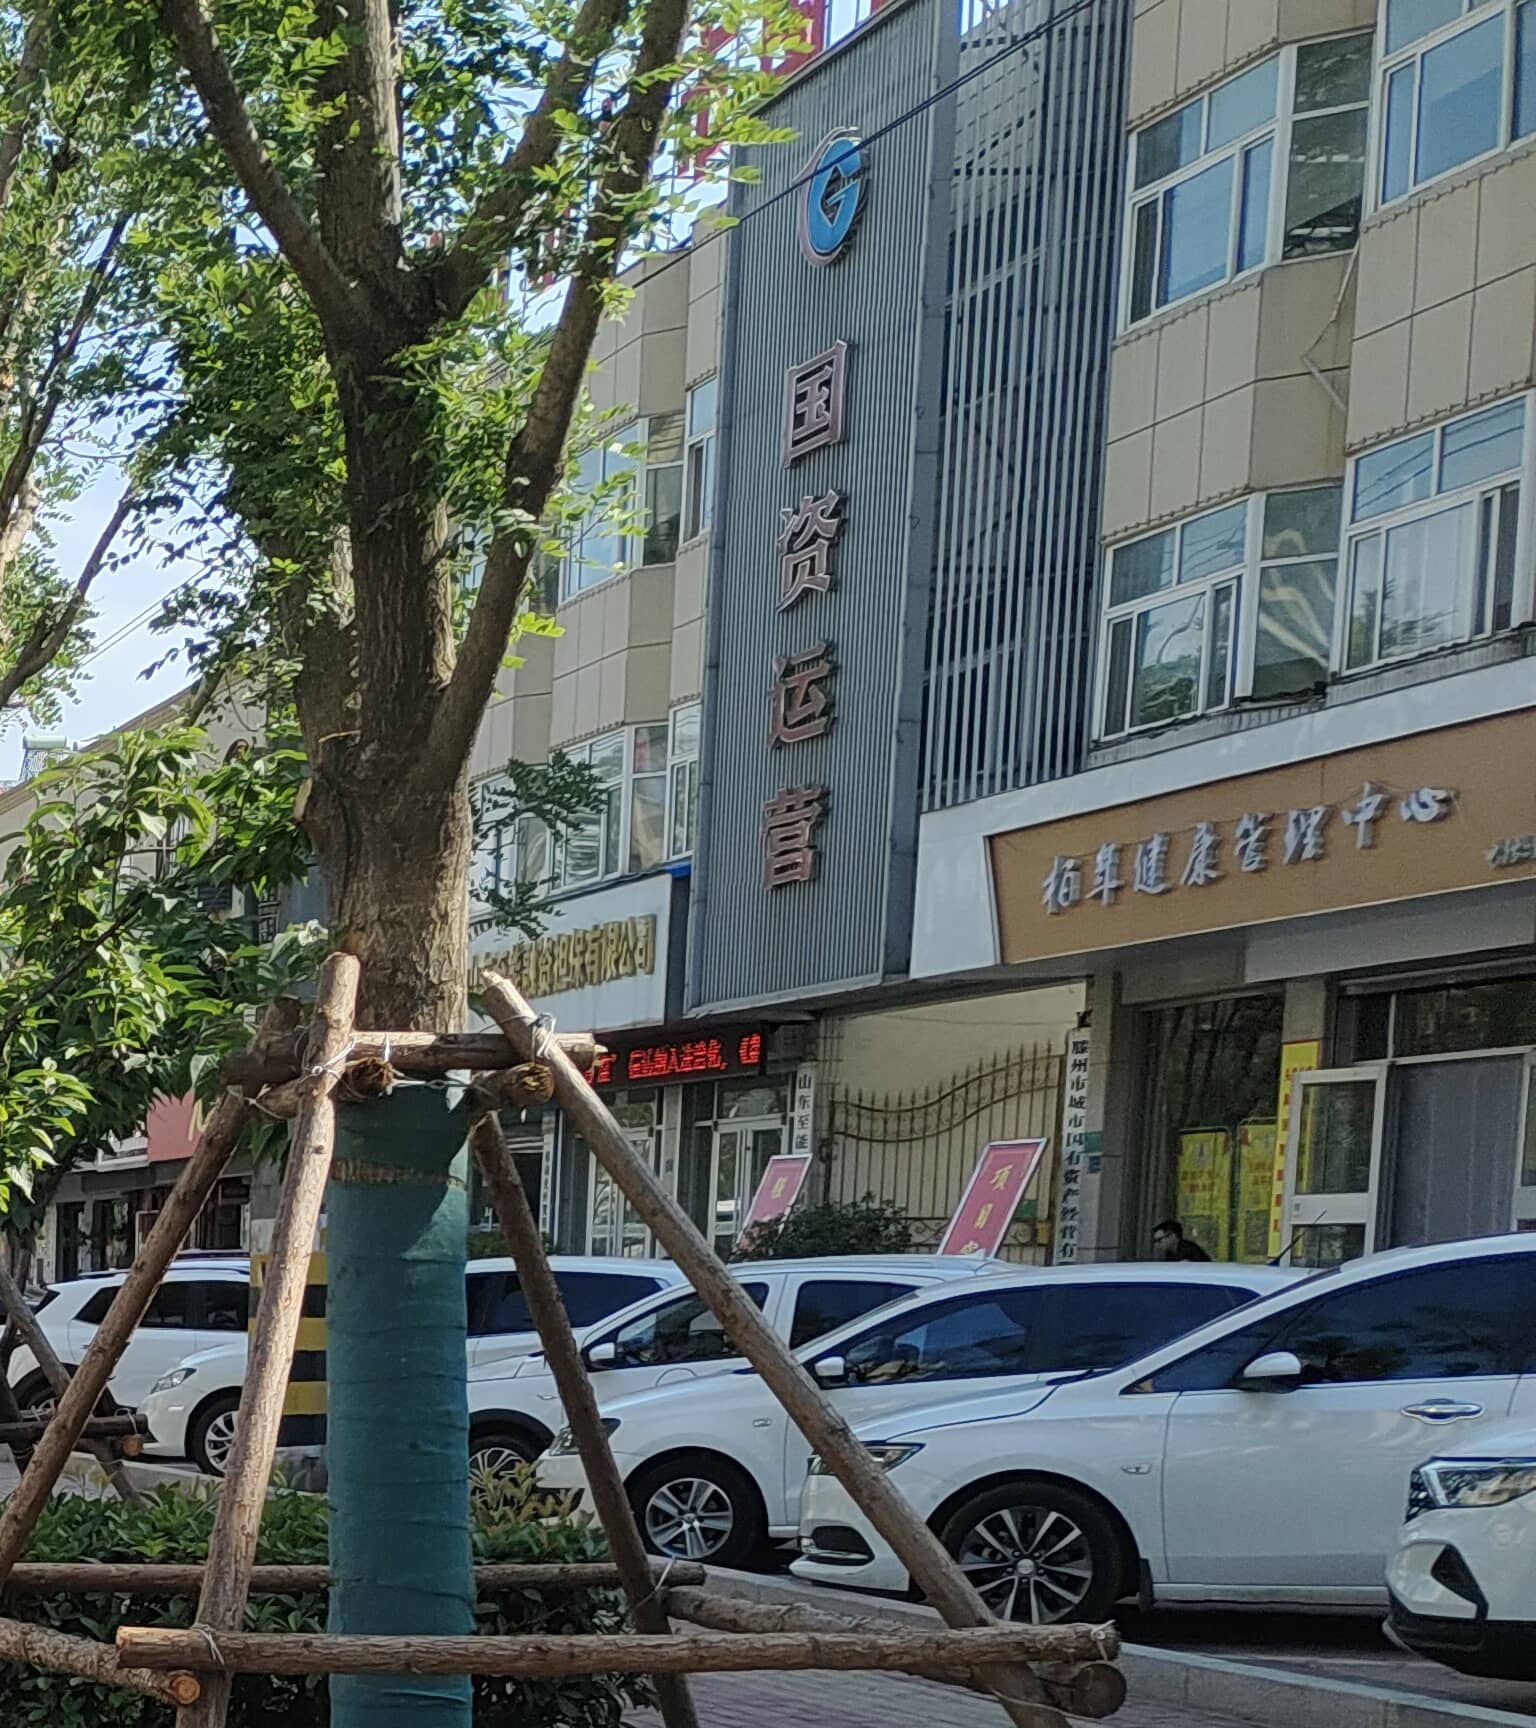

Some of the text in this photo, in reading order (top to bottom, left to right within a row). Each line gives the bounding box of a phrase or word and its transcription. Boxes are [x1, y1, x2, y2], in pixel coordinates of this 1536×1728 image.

[762, 338, 848, 892] 国资运营
[1041, 781, 1456, 915] 柏年健康管理中心
[1056, 1039, 1089, 1264] 滕州市城市国有资产经营有
